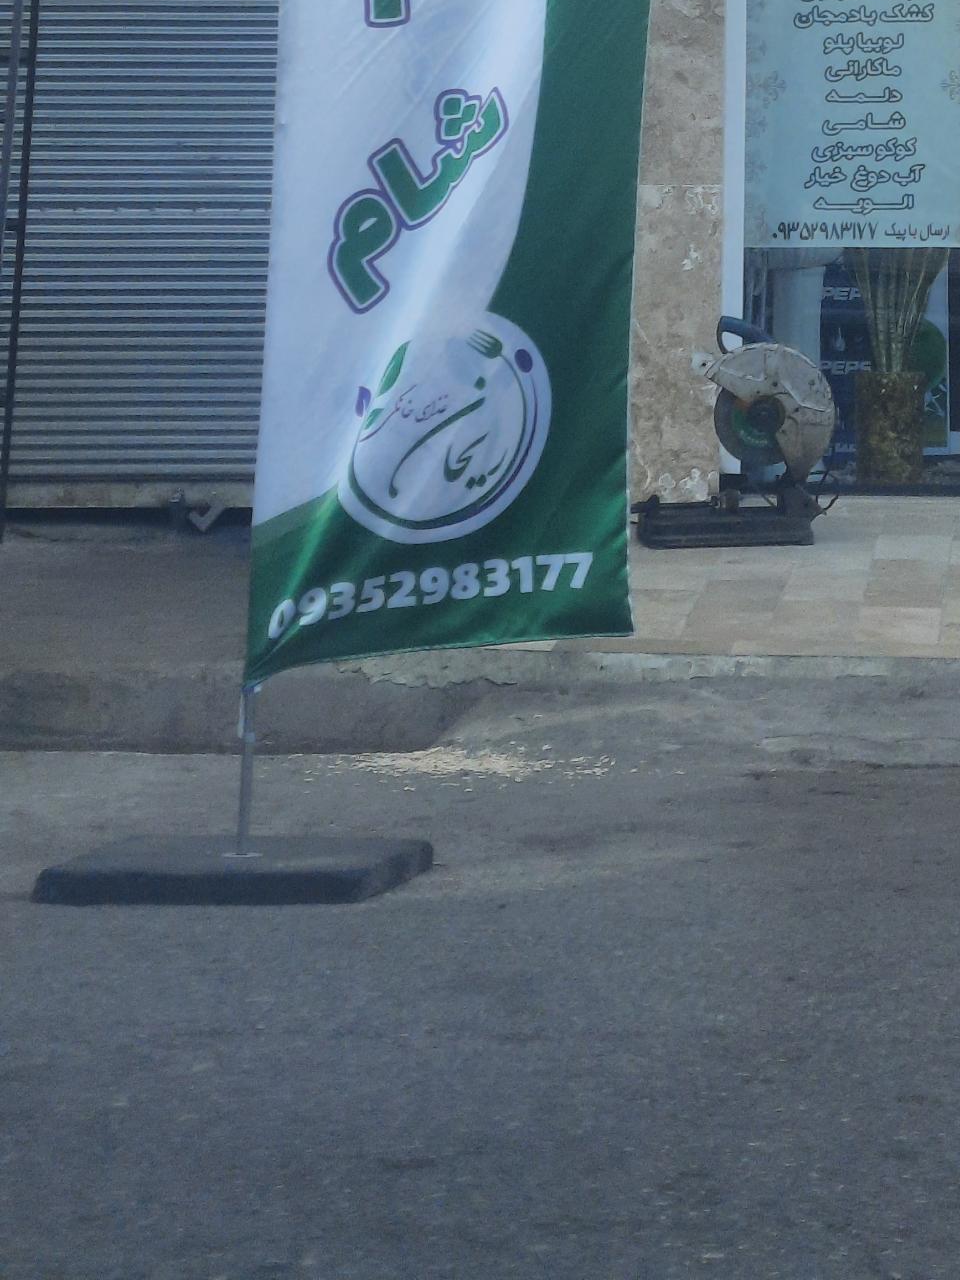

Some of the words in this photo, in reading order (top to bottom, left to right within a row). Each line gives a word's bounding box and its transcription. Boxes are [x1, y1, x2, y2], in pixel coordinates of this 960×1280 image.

[793, 5, 877, 28] بادمجان
[880, 4, 934, 22] کشک
[823, 33, 855, 55] پلو
[857, 32, 904, 54] لوبیا
[825, 87, 903, 104] دلمه
[822, 111, 906, 136] شامی
[811, 141, 873, 162] سبزی
[875, 137, 917, 161] کوکو
[804, 167, 846, 189] خیار
[851, 165, 890, 192] دوغ
[892, 164, 925, 186] آب
[328, 88, 508, 313] شام
[813, 194, 914, 215] الویه
[884, 223, 907, 242] پیک
[919, 223, 950, 241] ارسال
[823, 287, 862, 301] PEP
[820, 361, 871, 375] PEPS
[268, 552, 594, 640] 09352983177
